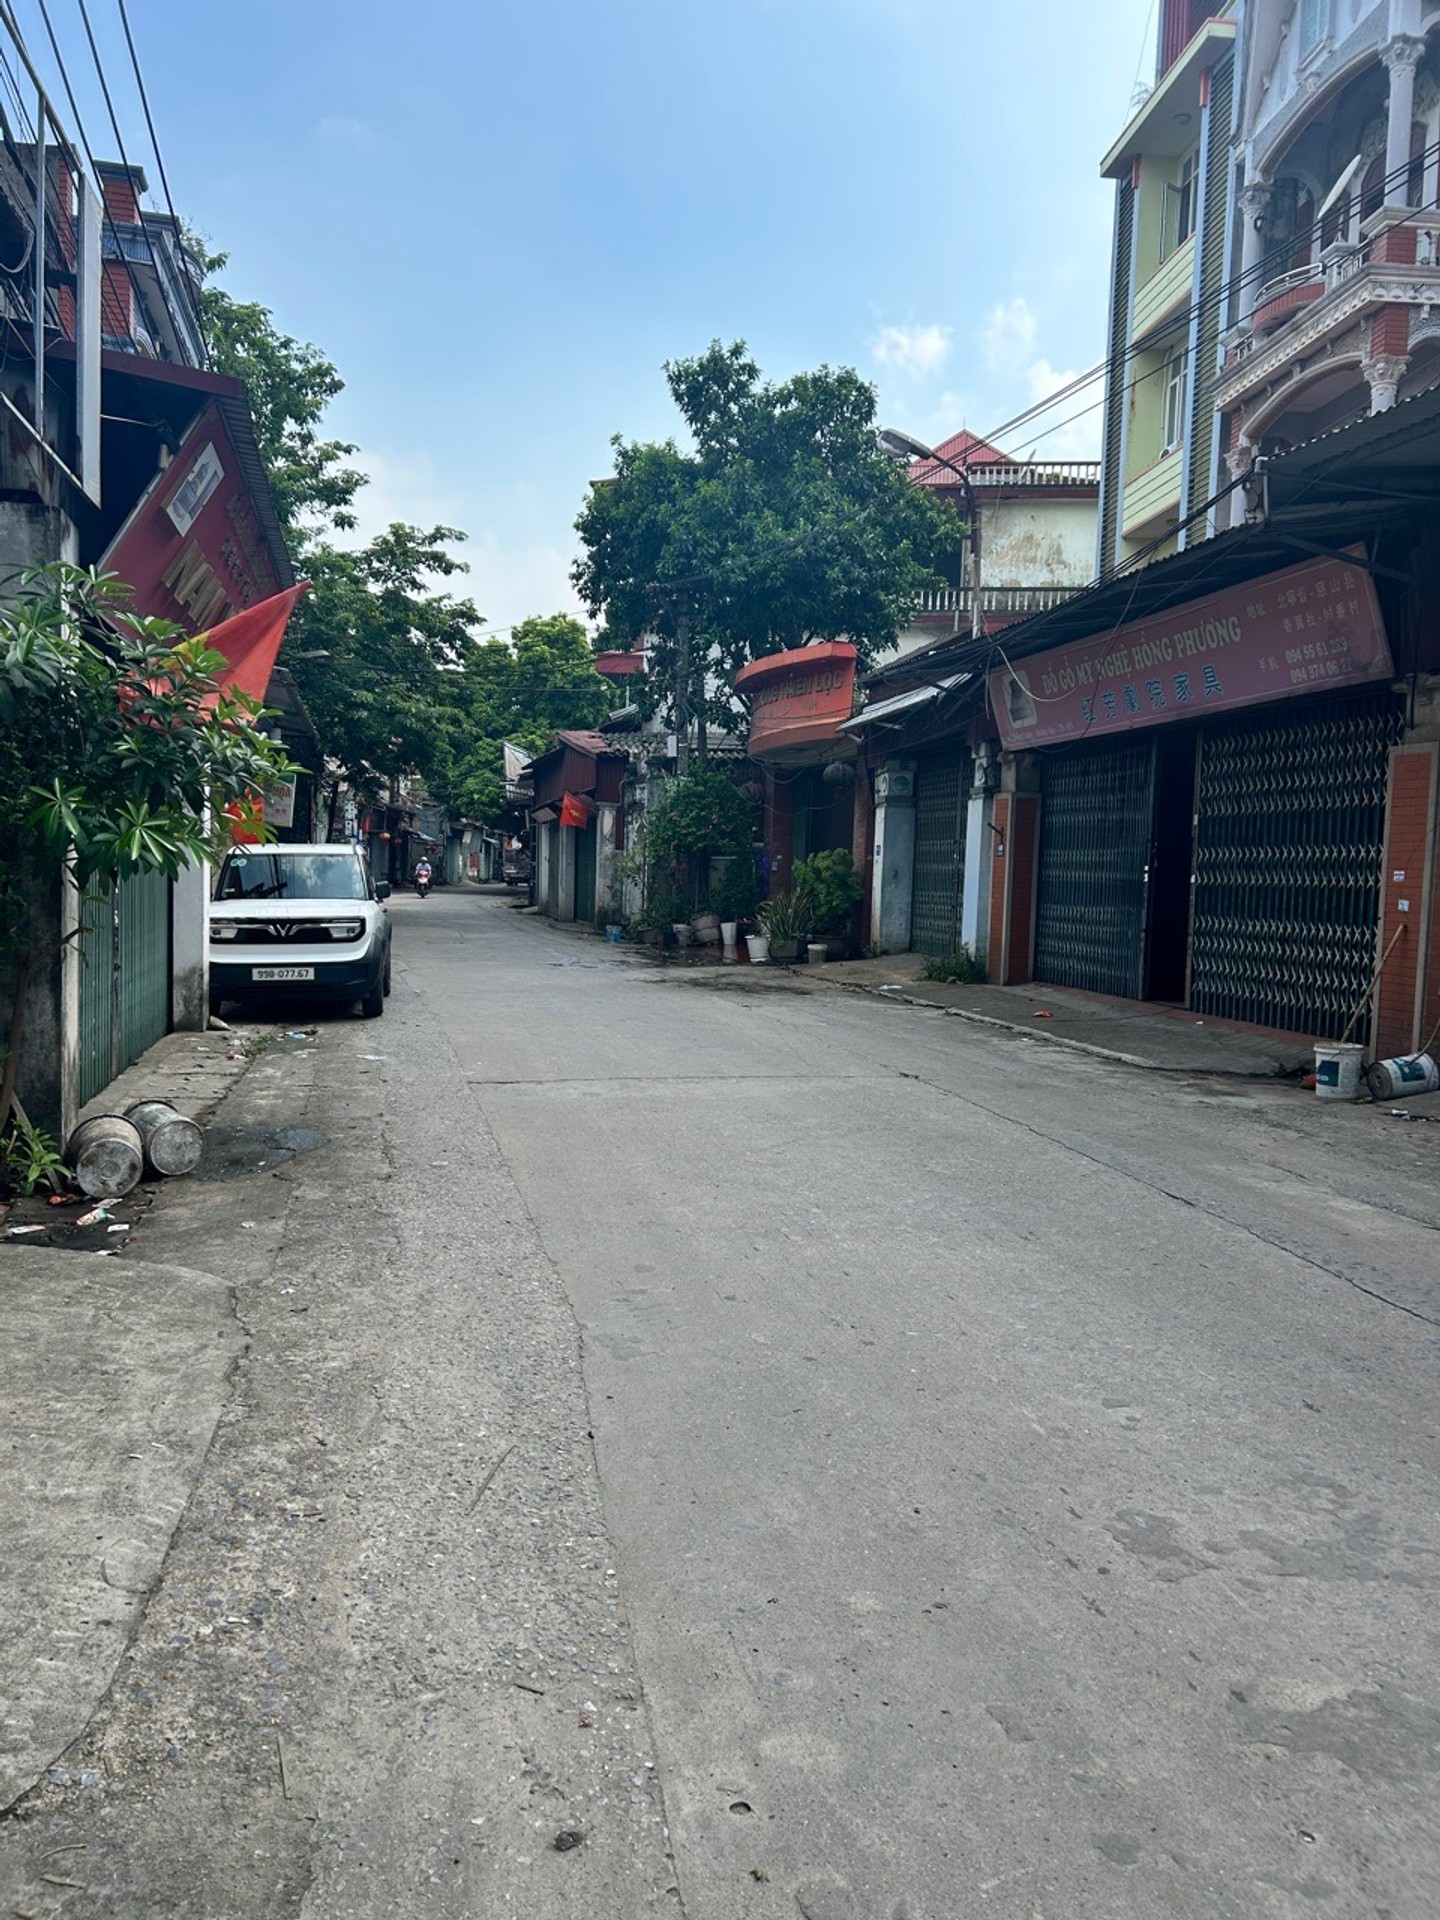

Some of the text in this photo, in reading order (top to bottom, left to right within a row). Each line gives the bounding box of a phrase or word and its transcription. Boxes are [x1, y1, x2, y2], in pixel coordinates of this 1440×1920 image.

[1096, 644, 1132, 680] NGHỆ
[1131, 630, 1173, 670] HỒNG
[1173, 616, 1242, 658] PHƯƠNG
[1303, 644, 1316, 659] 55
[1308, 663, 1326, 679] 374
